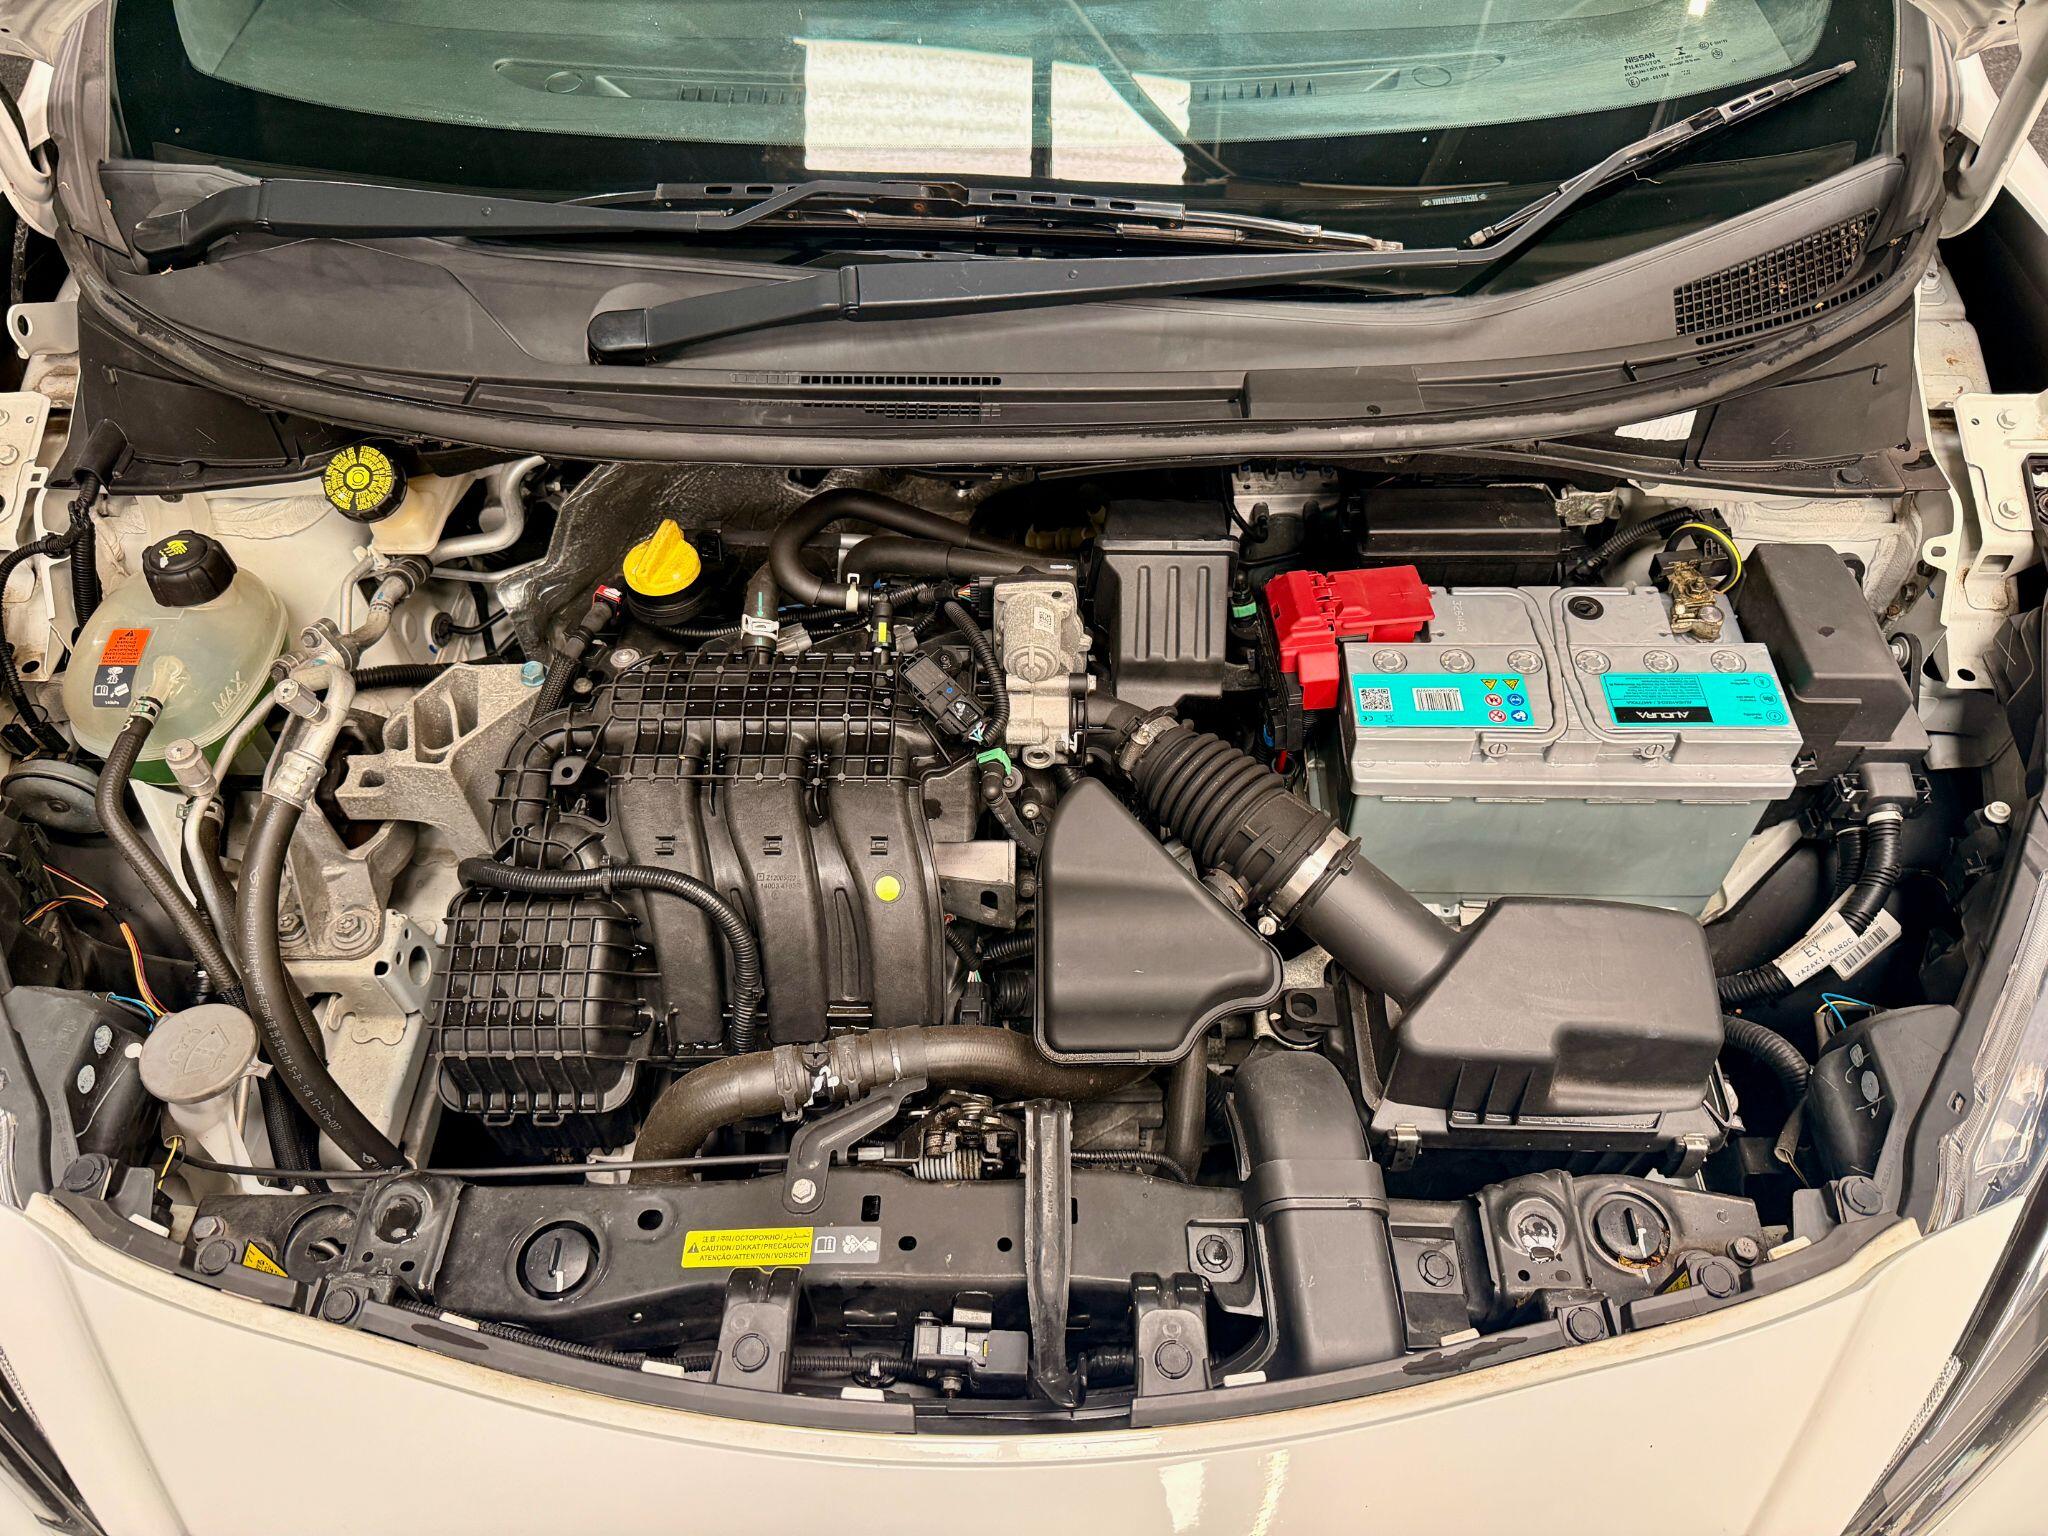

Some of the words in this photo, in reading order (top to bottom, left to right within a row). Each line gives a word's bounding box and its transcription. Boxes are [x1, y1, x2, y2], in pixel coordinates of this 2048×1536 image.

[1624, 59, 1662, 71] PILKINGTON
[1625, 52, 1656, 64] NISSAN
[212, 670, 249, 718] MAX
[1795, 956, 1825, 978] YAZAKI
[1828, 937, 1854, 957] MAROC
[1803, 942, 1822, 958] EY
